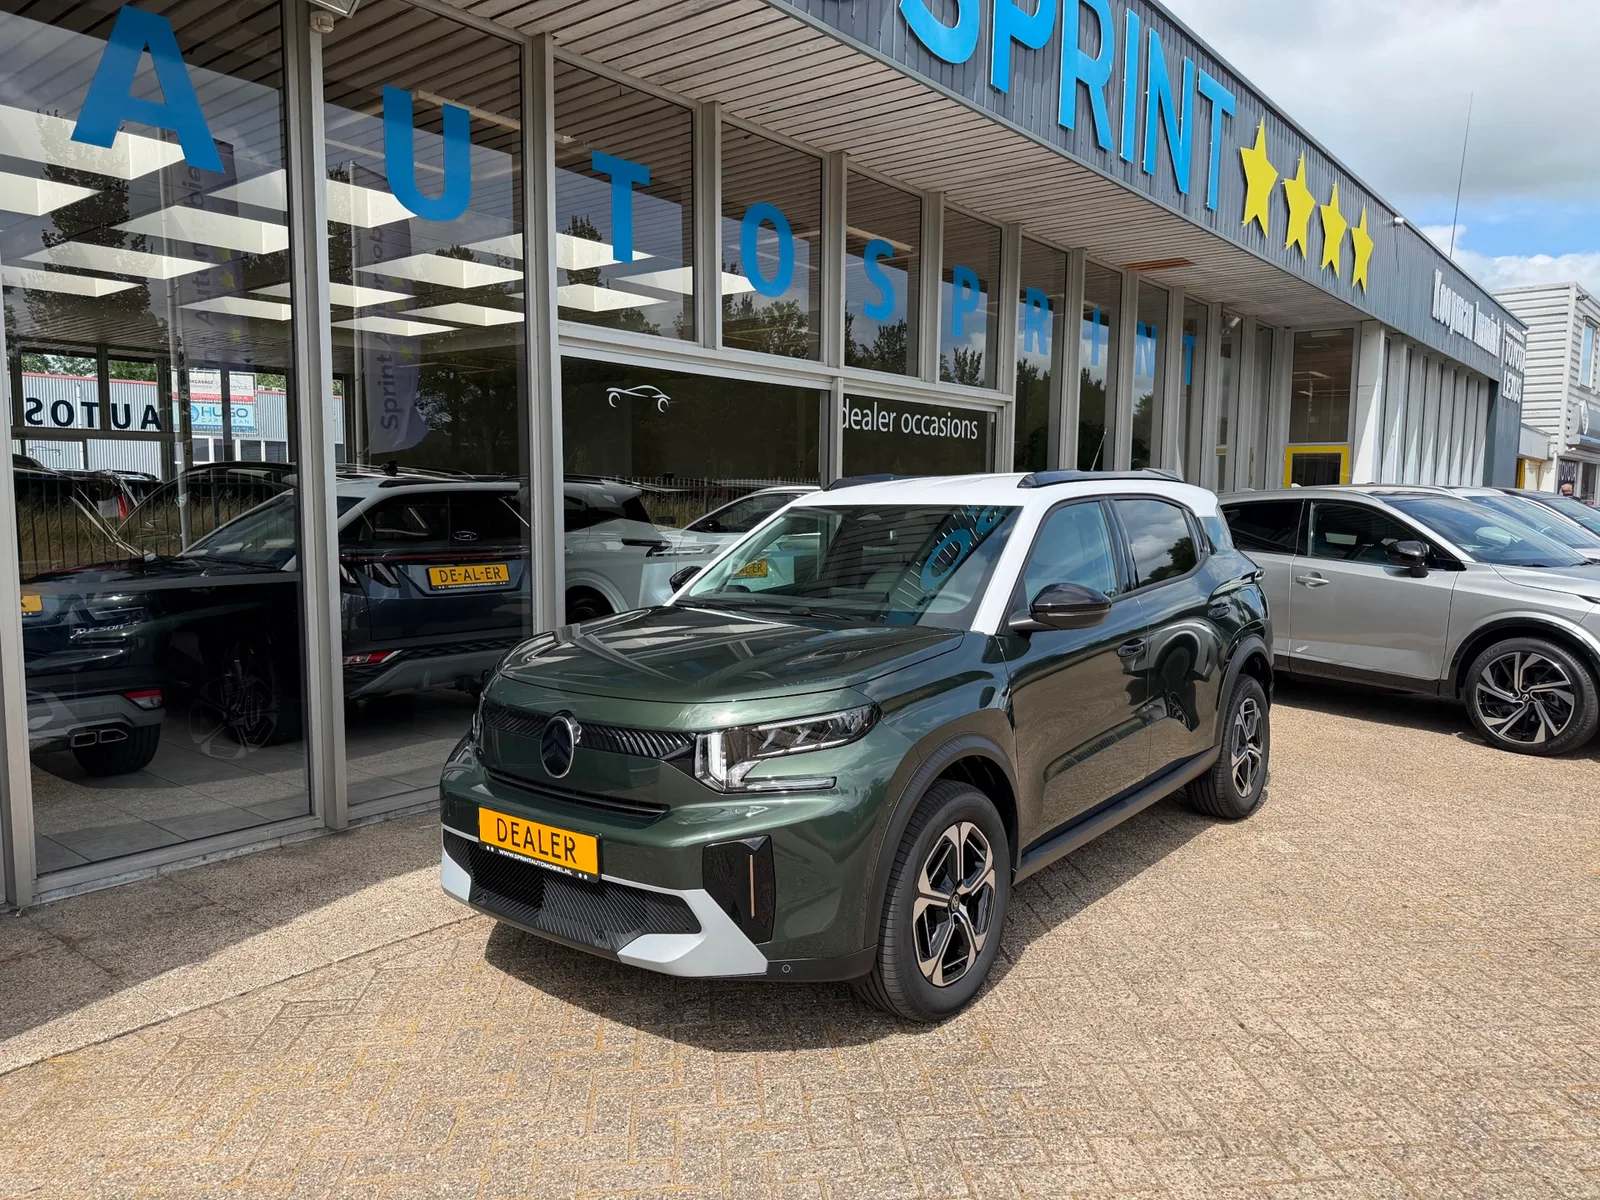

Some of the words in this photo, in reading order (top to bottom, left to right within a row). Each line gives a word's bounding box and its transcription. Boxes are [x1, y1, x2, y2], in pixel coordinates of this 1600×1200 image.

[377, 354, 402, 430] Sprint
[842, 398, 897, 433] dealer
[900, 412, 978, 440] occasions
[438, 566, 502, 583] DE-AL-ER
[496, 817, 577, 864] DEALER
